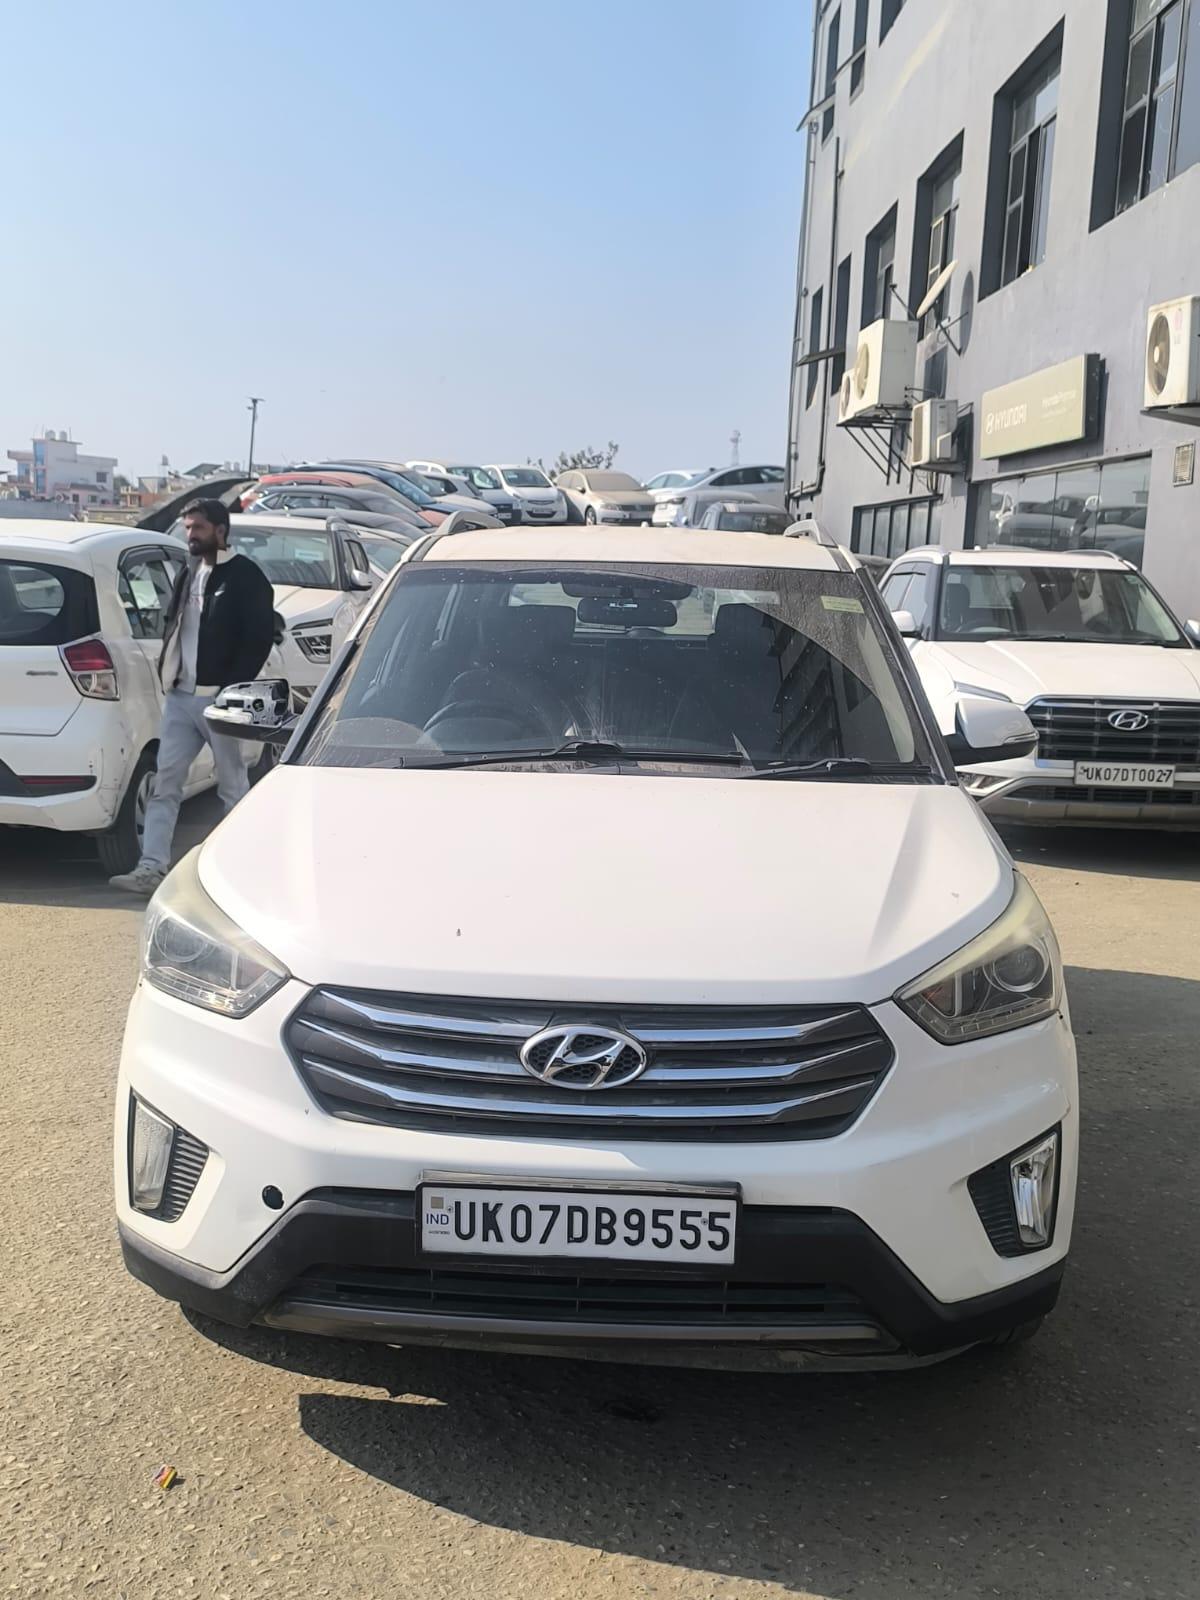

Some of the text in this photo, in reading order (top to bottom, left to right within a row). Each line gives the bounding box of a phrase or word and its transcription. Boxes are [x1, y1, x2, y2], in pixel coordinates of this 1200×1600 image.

[994, 403, 1027, 433] HYUNDAI
[1086, 767, 1173, 783] UK07DT0027
[426, 1213, 449, 1225] IND
[454, 1200, 731, 1251] UK07DB9555
